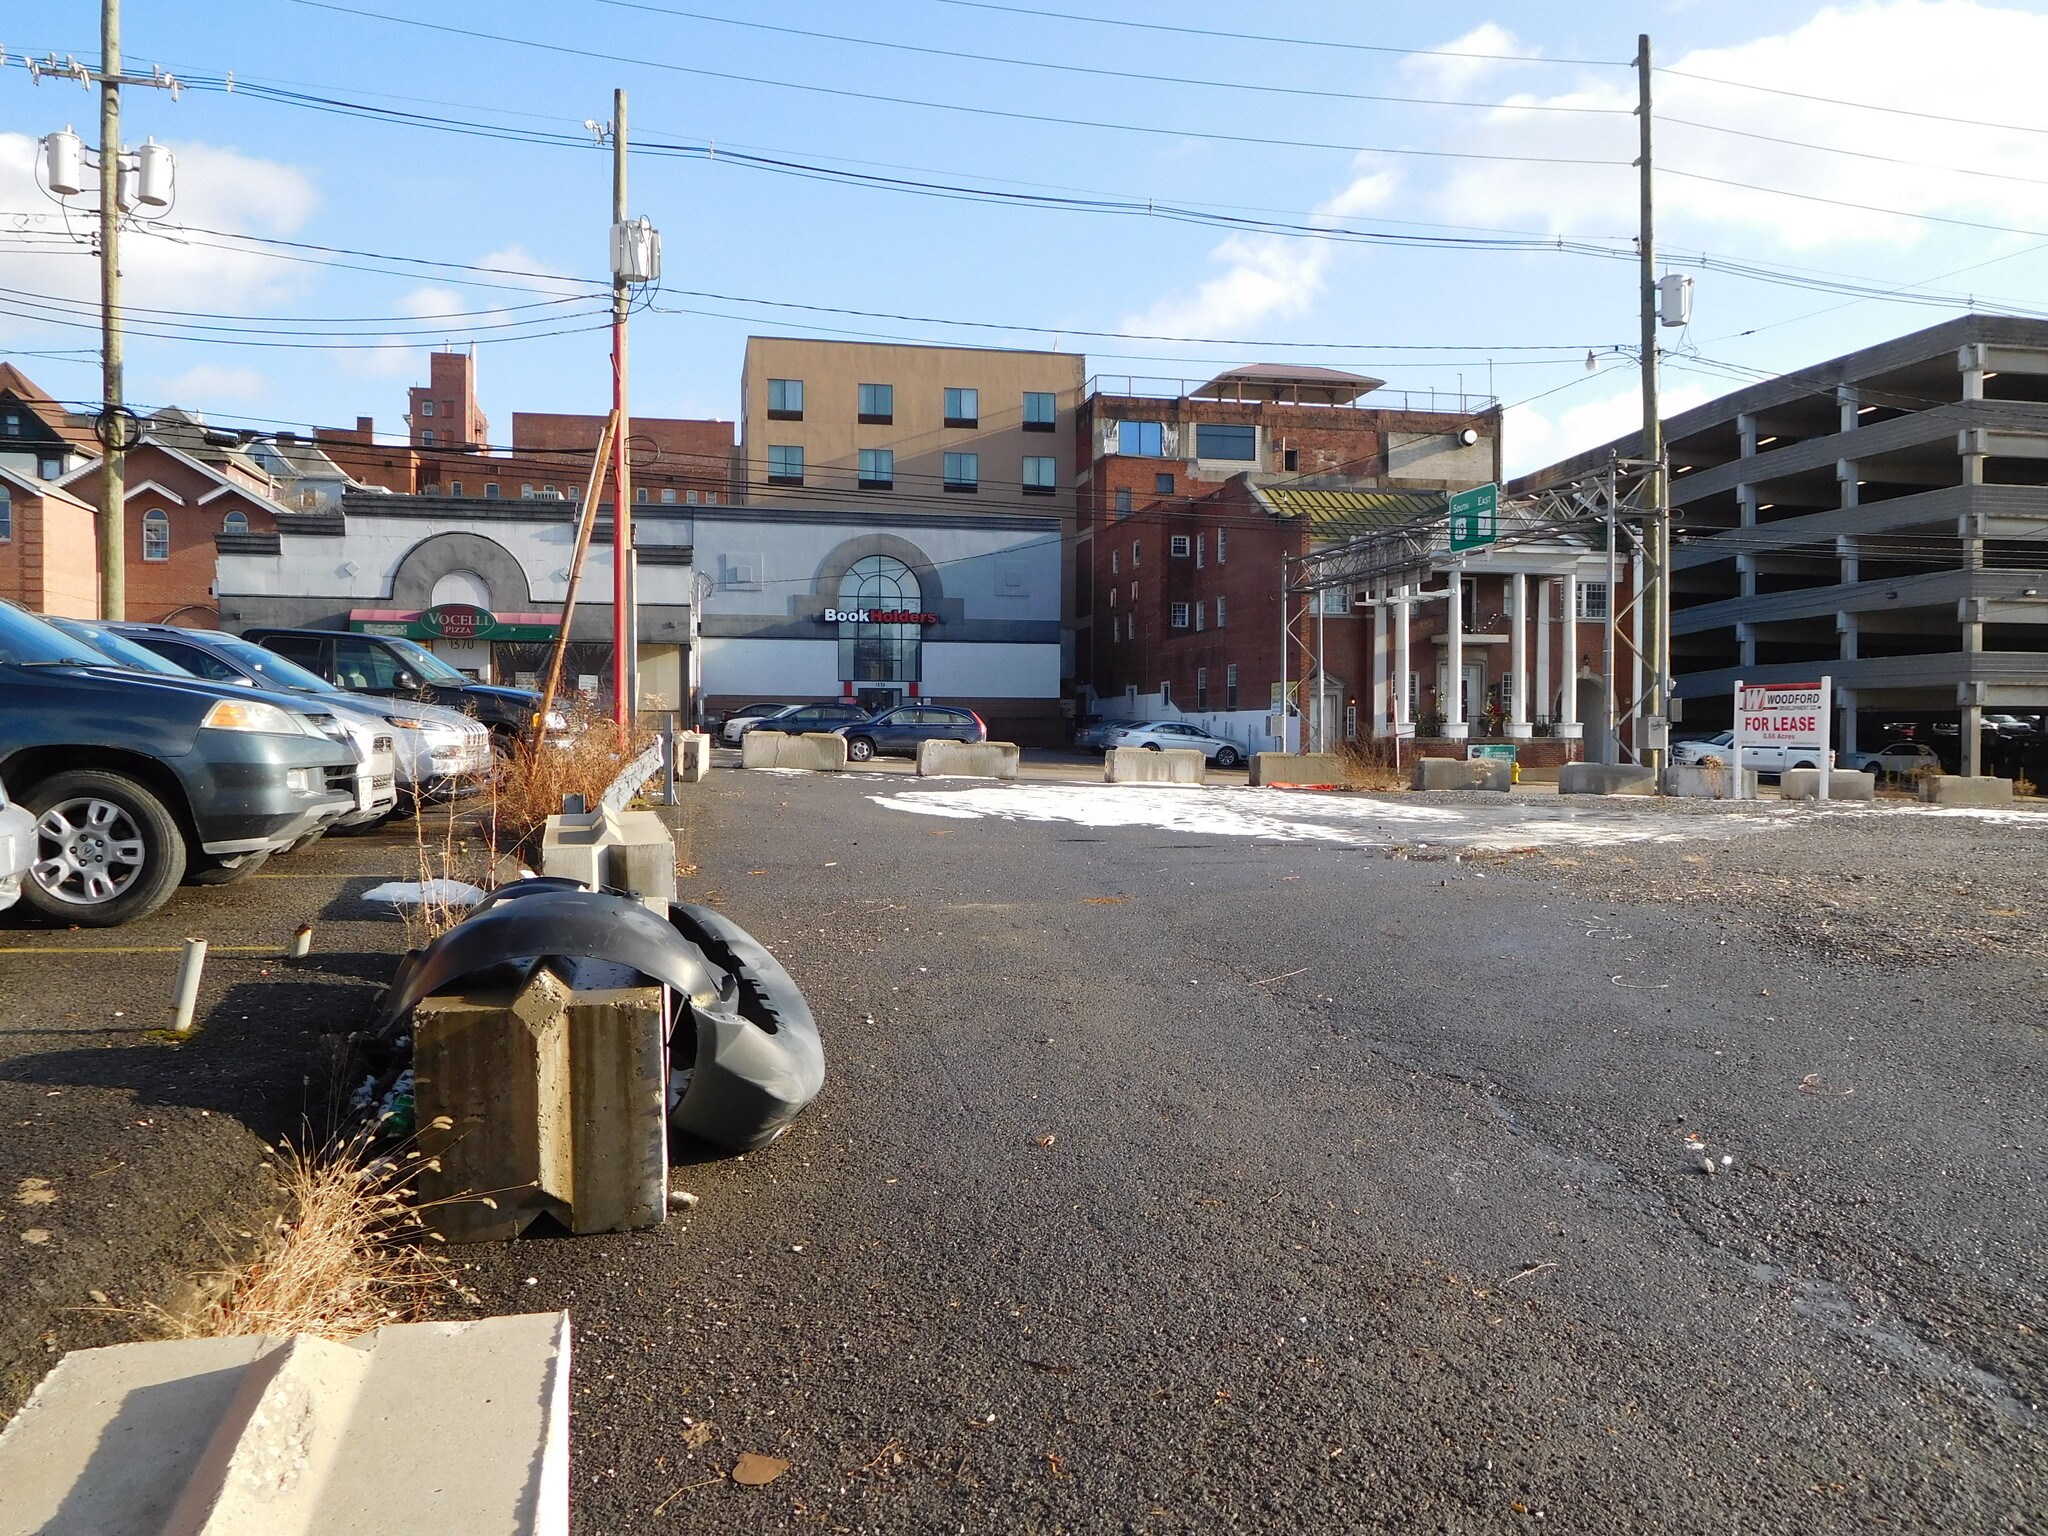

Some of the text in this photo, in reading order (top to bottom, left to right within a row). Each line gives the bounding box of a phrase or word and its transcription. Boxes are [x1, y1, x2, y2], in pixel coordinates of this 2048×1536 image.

[428, 612, 489, 626] VOCELLI
[824, 608, 938, 624] BookHolders
[445, 625, 471, 634] PIZZA
[1767, 693, 1820, 705] WOODFORD
[1745, 717, 1816, 731] FOR LEASE
